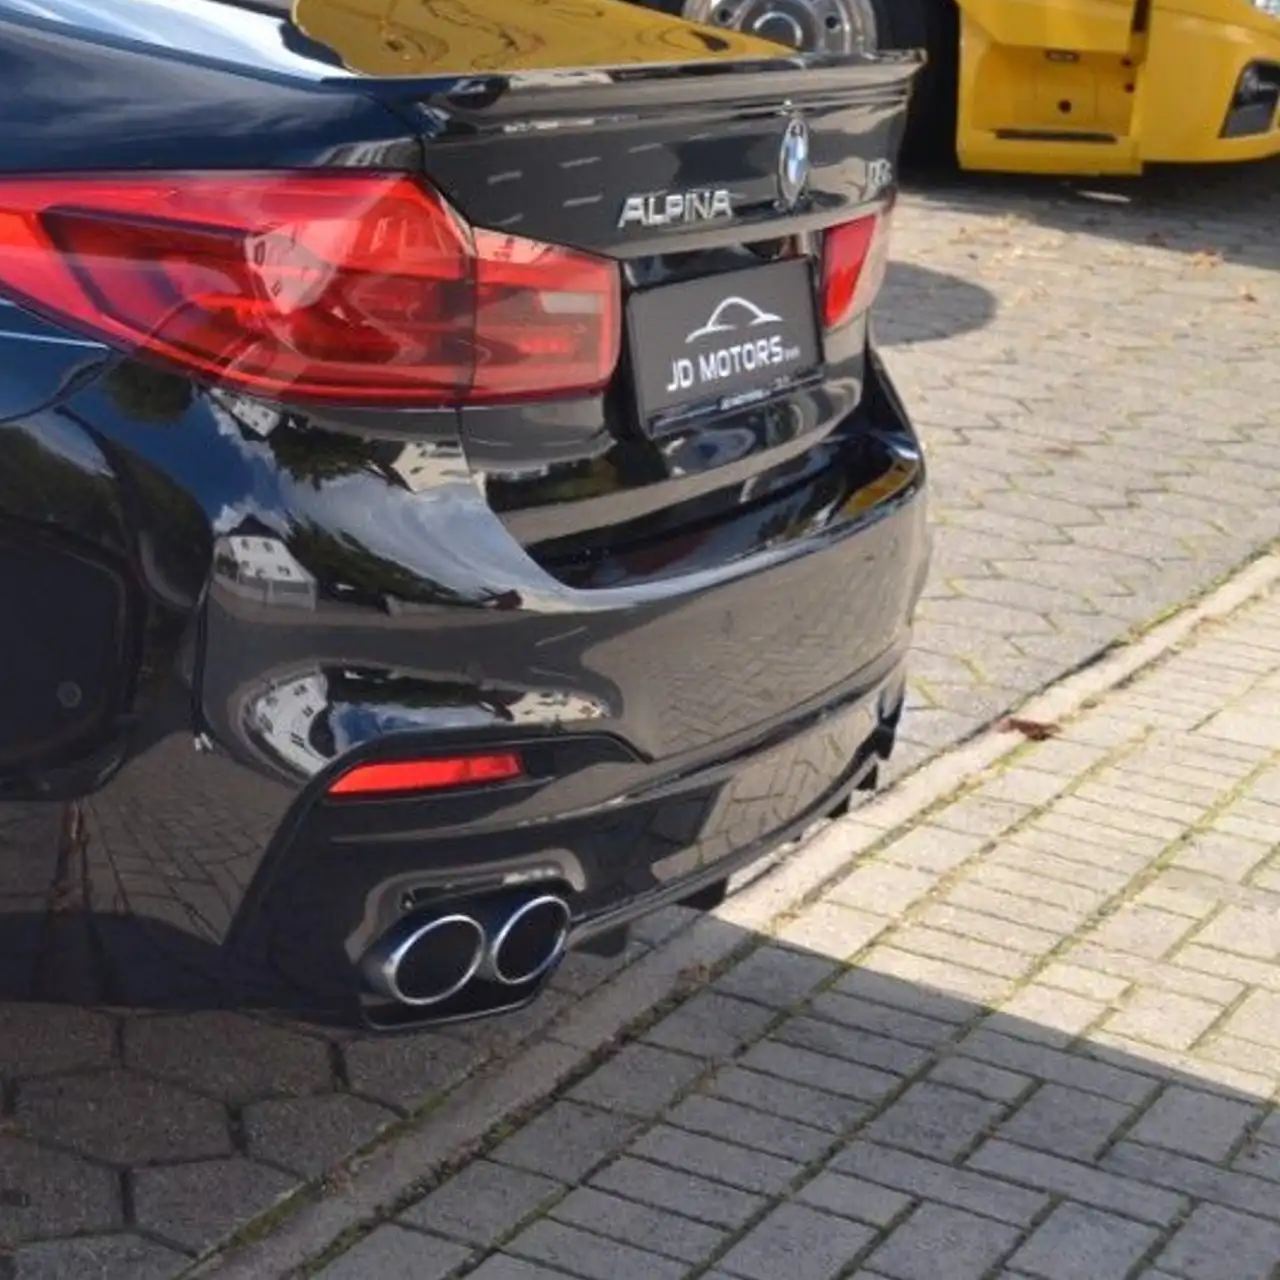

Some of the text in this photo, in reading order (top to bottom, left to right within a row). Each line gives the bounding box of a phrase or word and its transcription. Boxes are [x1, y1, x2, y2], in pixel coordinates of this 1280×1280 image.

[617, 190, 733, 228] ALPINA
[666, 335, 783, 392] JD MOTORS
